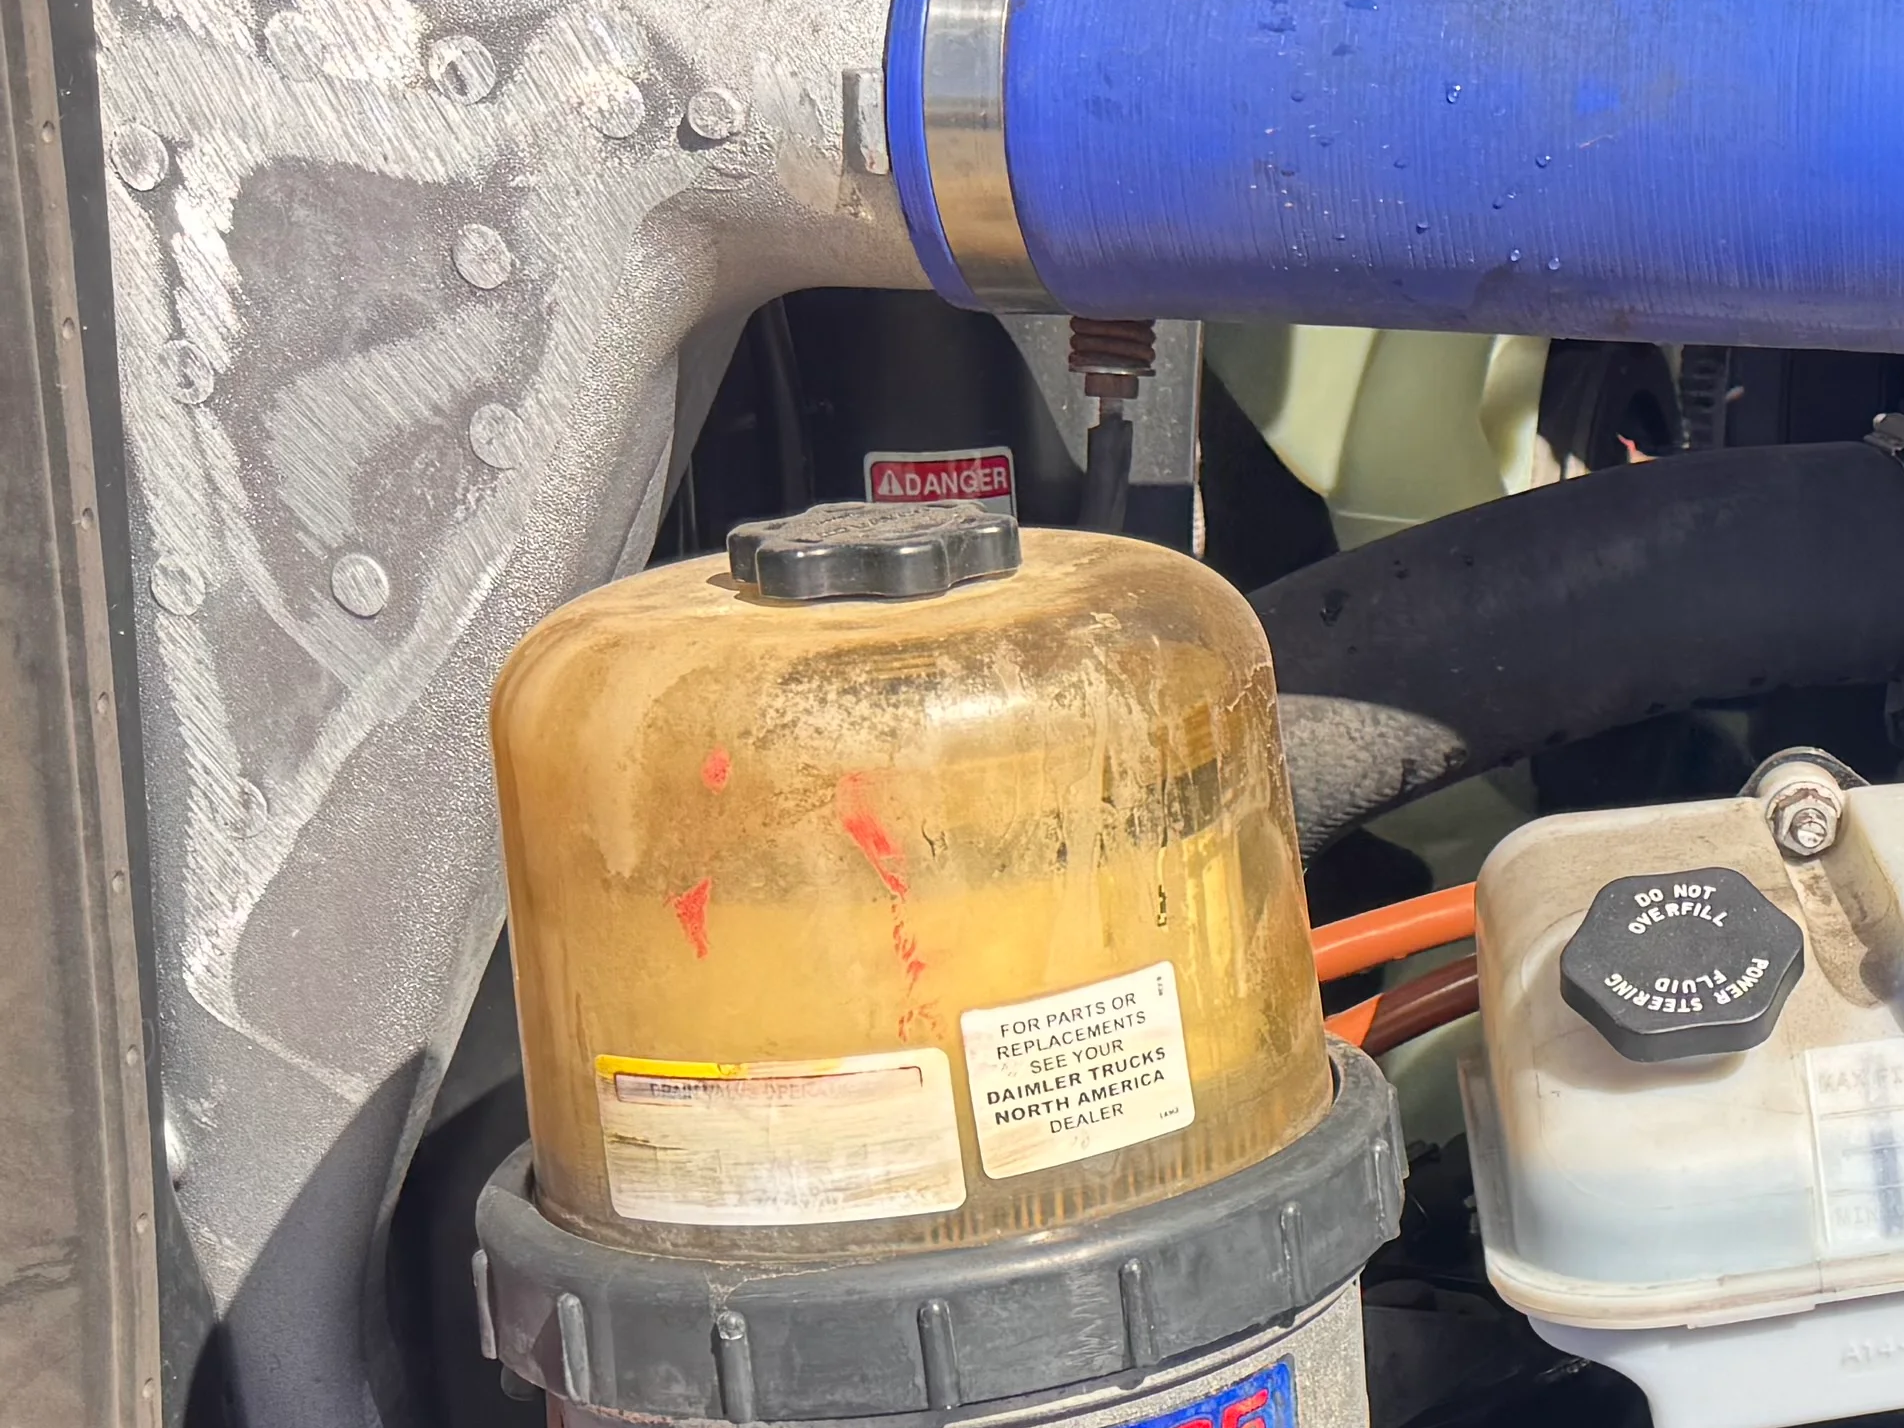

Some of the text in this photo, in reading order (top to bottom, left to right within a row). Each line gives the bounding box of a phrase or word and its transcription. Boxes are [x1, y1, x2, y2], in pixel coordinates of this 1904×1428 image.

[904, 466, 1008, 497] DANGER
[1634, 884, 1716, 908] DO NOT
[1628, 901, 1729, 935] OVERFILL
[1604, 957, 1770, 1012] POWER STEERING
[1655, 969, 1727, 995] FLUID
[999, 992, 1137, 1038] FOR PARTS OR
[996, 1010, 1147, 1060] REPLACEMENTS
[1029, 1040, 1124, 1075] SEE YOUR
[985, 1046, 1167, 1107] DAIMLER TRUCKS
[994, 1068, 1166, 1127] NORTH AMERICA
[1049, 1104, 1124, 1134] DEALER
